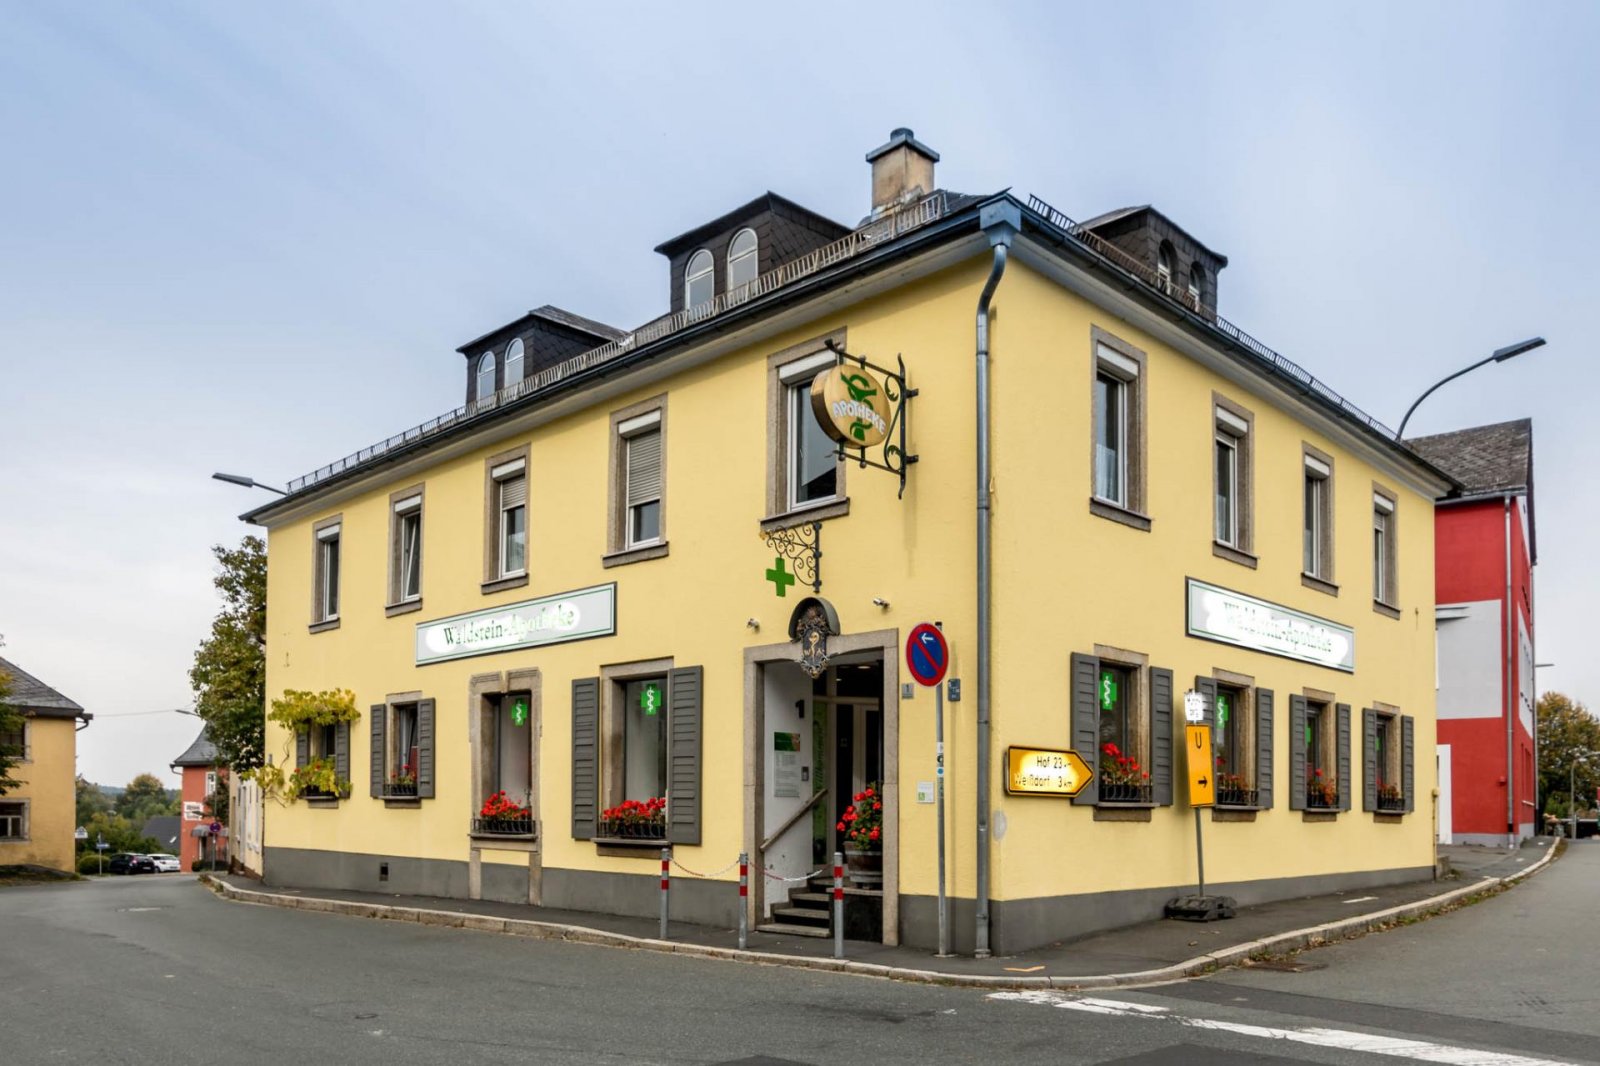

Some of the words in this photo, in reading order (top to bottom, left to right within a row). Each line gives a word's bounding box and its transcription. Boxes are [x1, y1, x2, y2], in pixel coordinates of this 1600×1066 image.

[832, 399, 887, 436] APOTHEKE
[795, 699, 805, 718] 1
[1195, 731, 1202, 749] U
[1036, 756, 1050, 768] Hof
[1053, 756, 1063, 769] 23
[1058, 776, 1063, 788] 3
